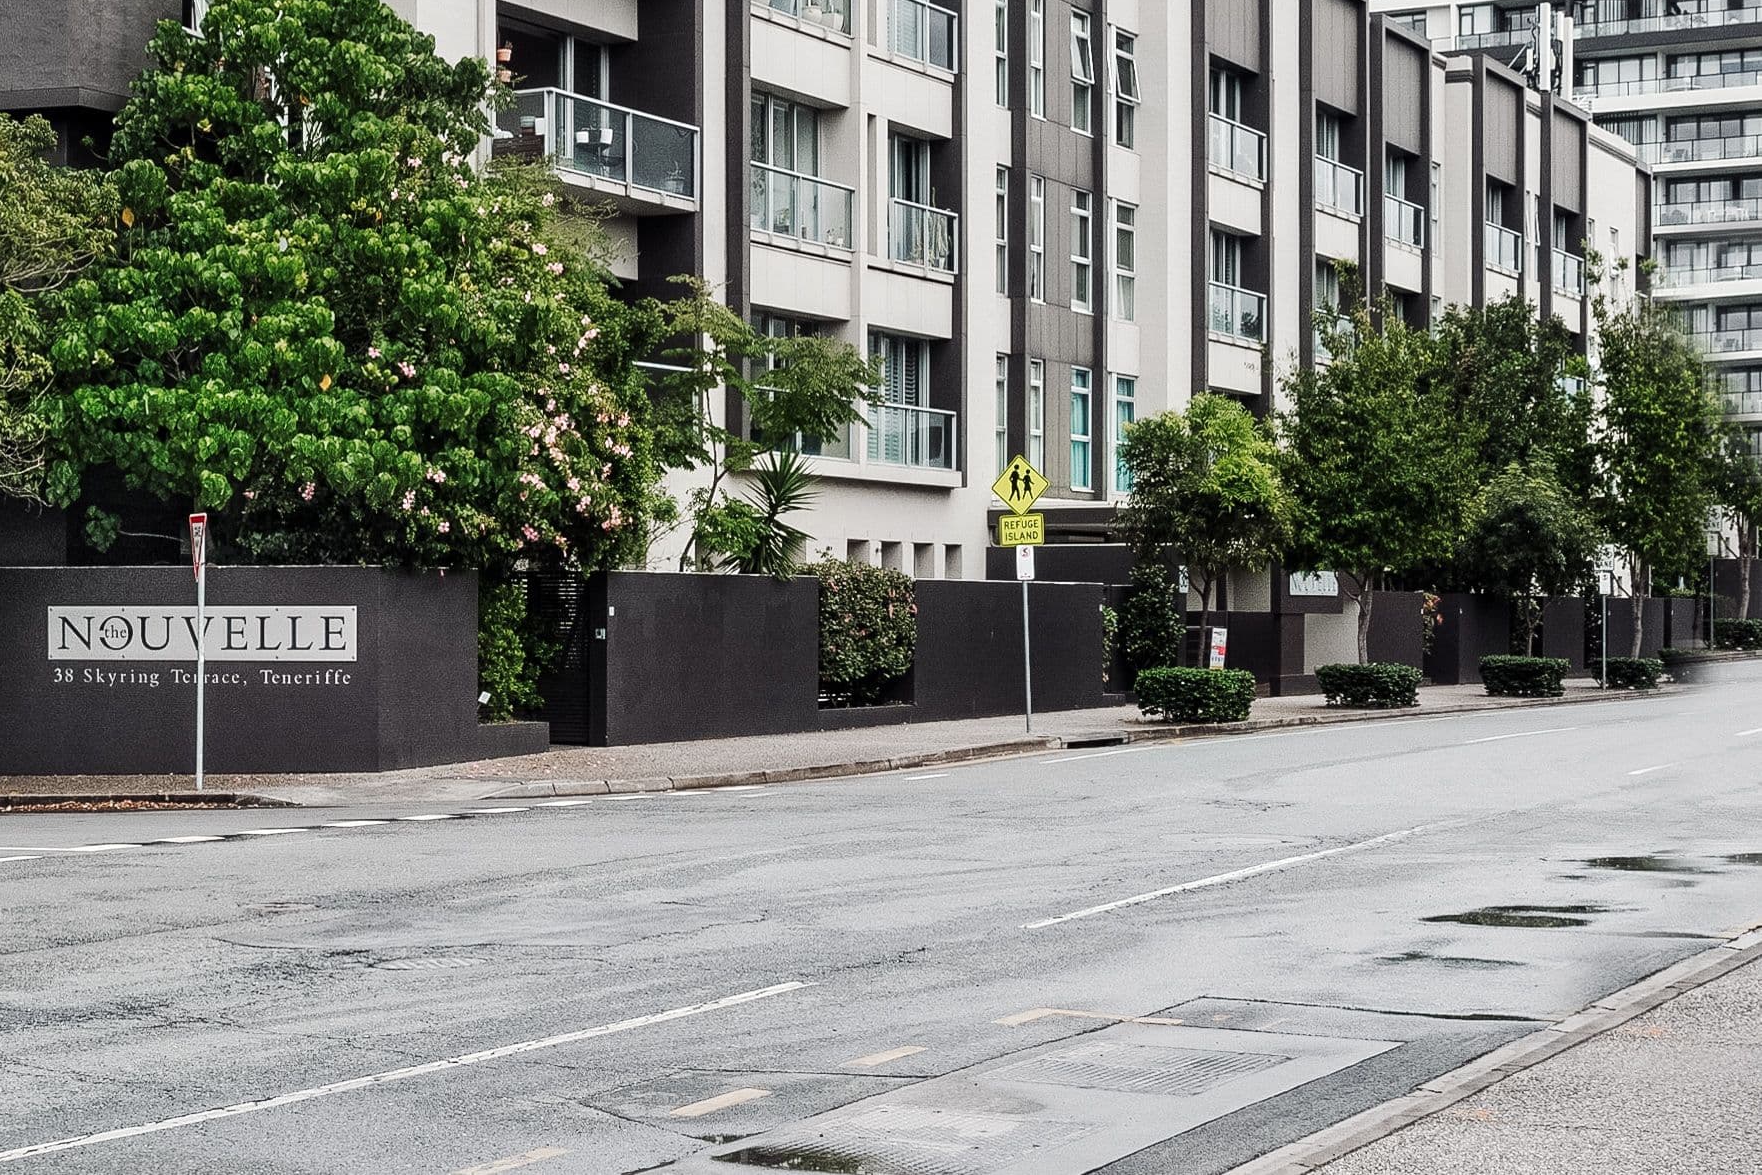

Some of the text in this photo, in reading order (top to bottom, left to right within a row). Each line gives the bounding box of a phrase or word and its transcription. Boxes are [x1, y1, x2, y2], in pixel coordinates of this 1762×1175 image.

[1004, 519, 1039, 530] REFUGE
[1005, 531, 1039, 541] ISLAND
[57, 615, 348, 651] NOUVELLE
[104, 627, 128, 639] the
[53, 668, 74, 683] 38
[83, 667, 160, 687] Skyring
[259, 668, 352, 684] Teneriffe
